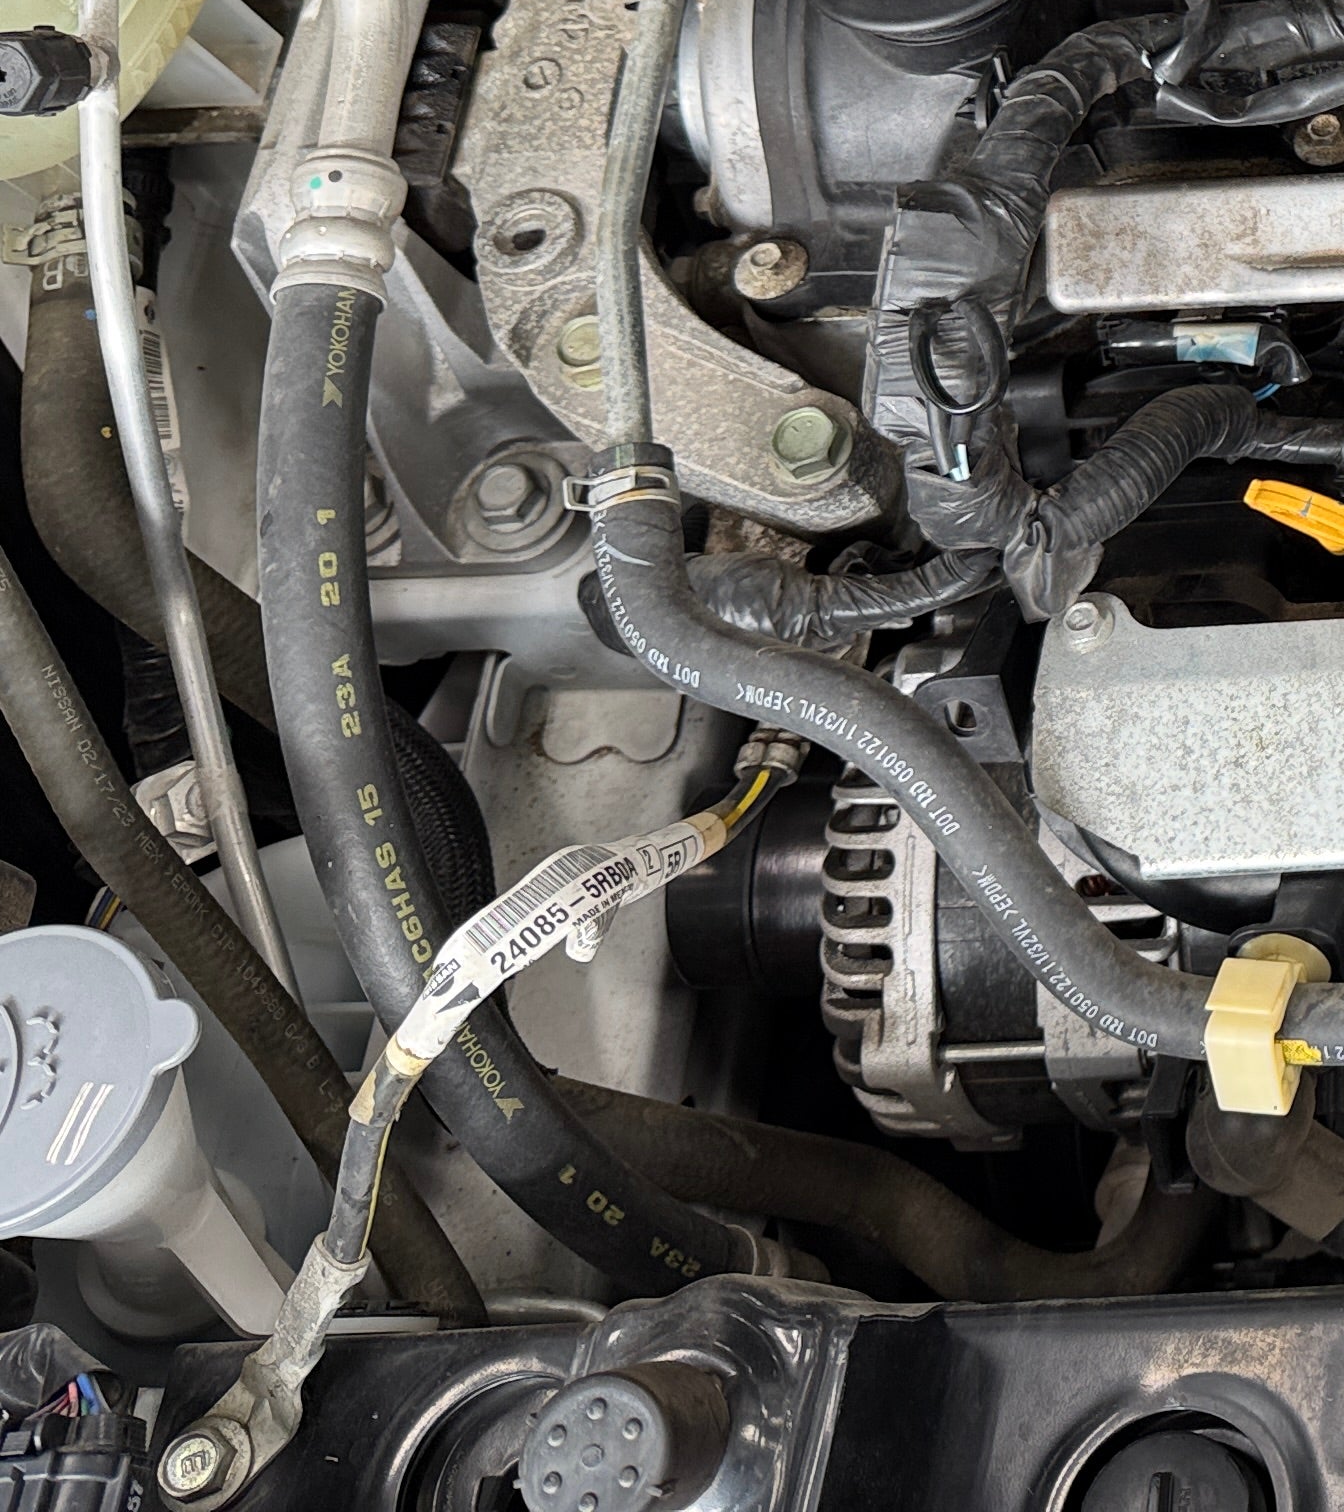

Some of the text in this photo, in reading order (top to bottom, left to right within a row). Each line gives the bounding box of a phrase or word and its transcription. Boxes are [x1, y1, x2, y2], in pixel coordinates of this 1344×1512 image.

[318, 551, 341, 608] 20
[609, 596, 648, 656] 050122
[331, 653, 364, 740] 23A
[672, 662, 702, 689] DOT
[734, 682, 795, 715] >EPDM<
[40, 662, 83, 735] NISSAN
[76, 738, 136, 828] 02/17/23
[856, 730, 916, 785] 050122
[356, 782, 385, 829] 15
[928, 804, 962, 837] DOT
[643, 849, 656, 872] 2
[571, 896, 612, 930] MADE IN
[971, 864, 1020, 922] >EPDM<
[1048, 966, 1099, 1020] 050122
[455, 1017, 508, 1102] YOKOHA
[1127, 1026, 1159, 1049] DOT
[585, 1189, 626, 1228] 20
